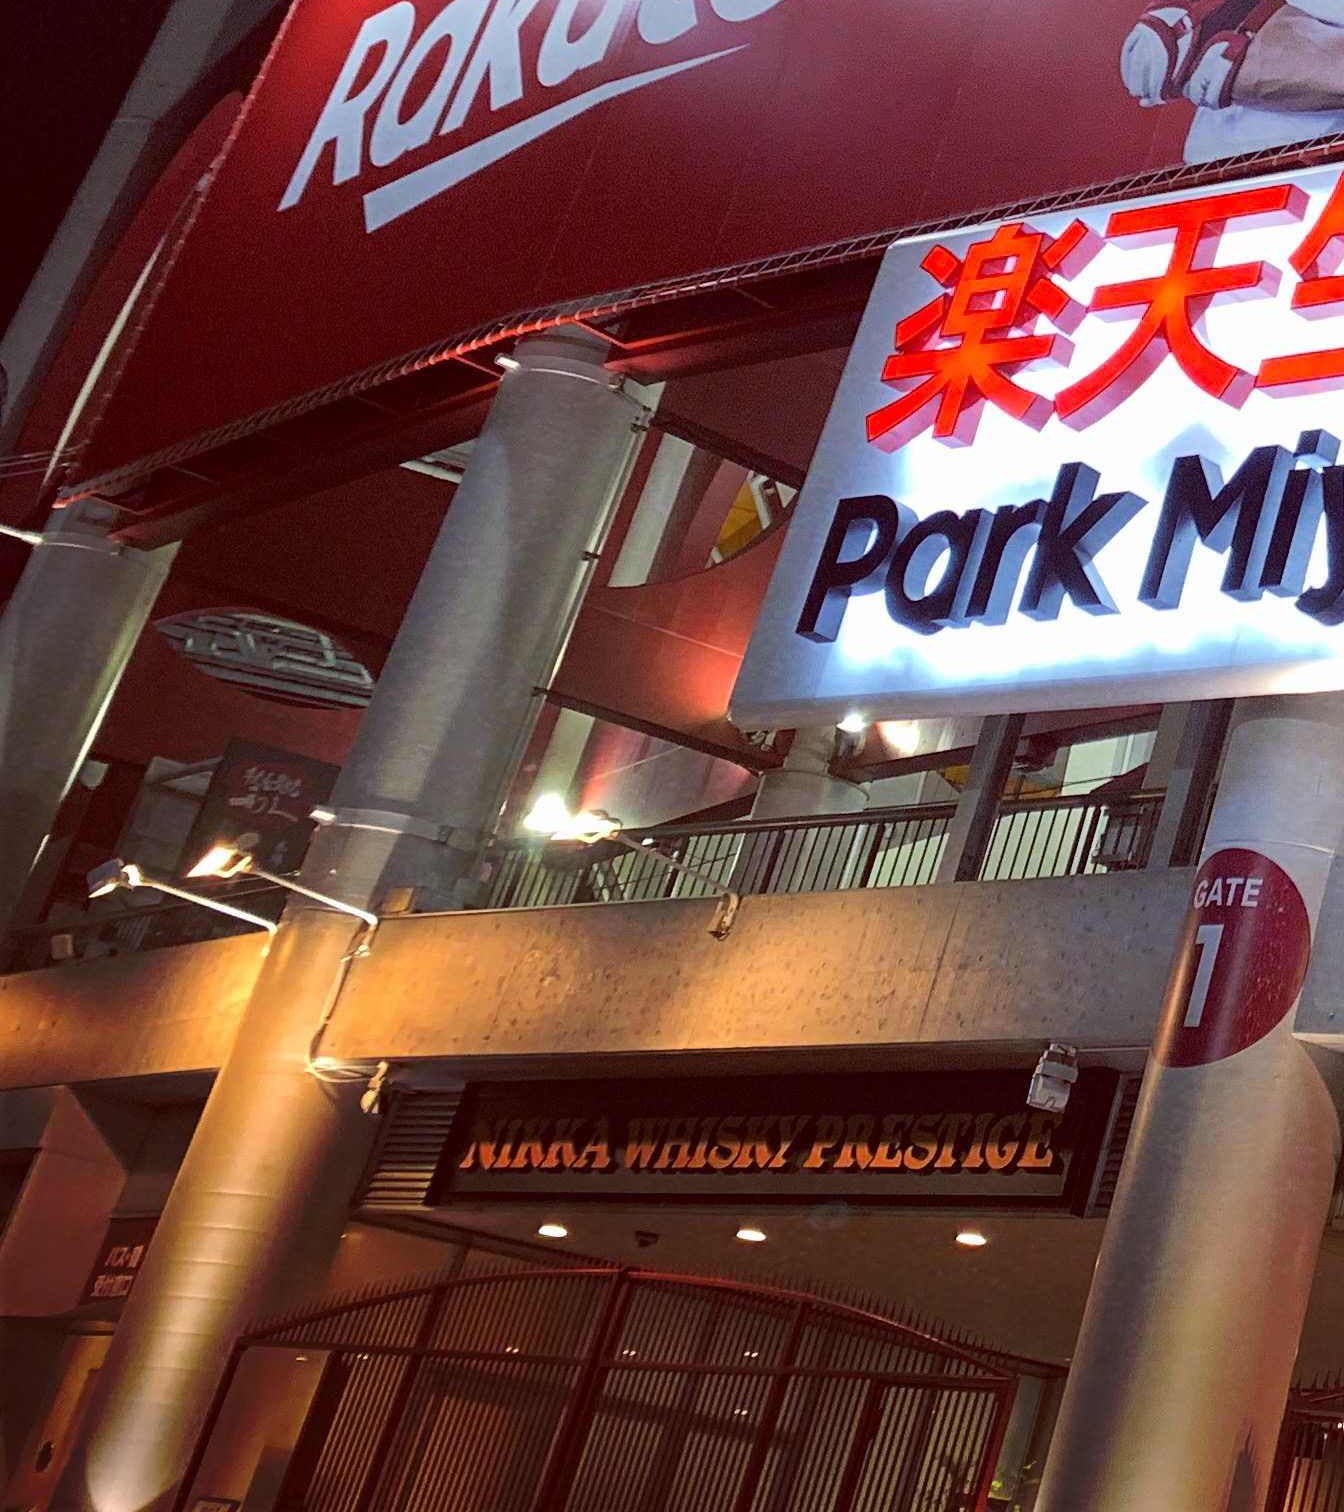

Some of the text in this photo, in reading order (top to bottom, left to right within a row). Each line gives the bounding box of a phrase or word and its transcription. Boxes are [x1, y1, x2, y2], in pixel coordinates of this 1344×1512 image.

[796, 459, 1147, 644] Park
[1193, 877, 1263, 908] GATE
[1184, 924, 1224, 1028] 1
[458, 1111, 1065, 1170] NIKKA WHISKY PRESTIGE
